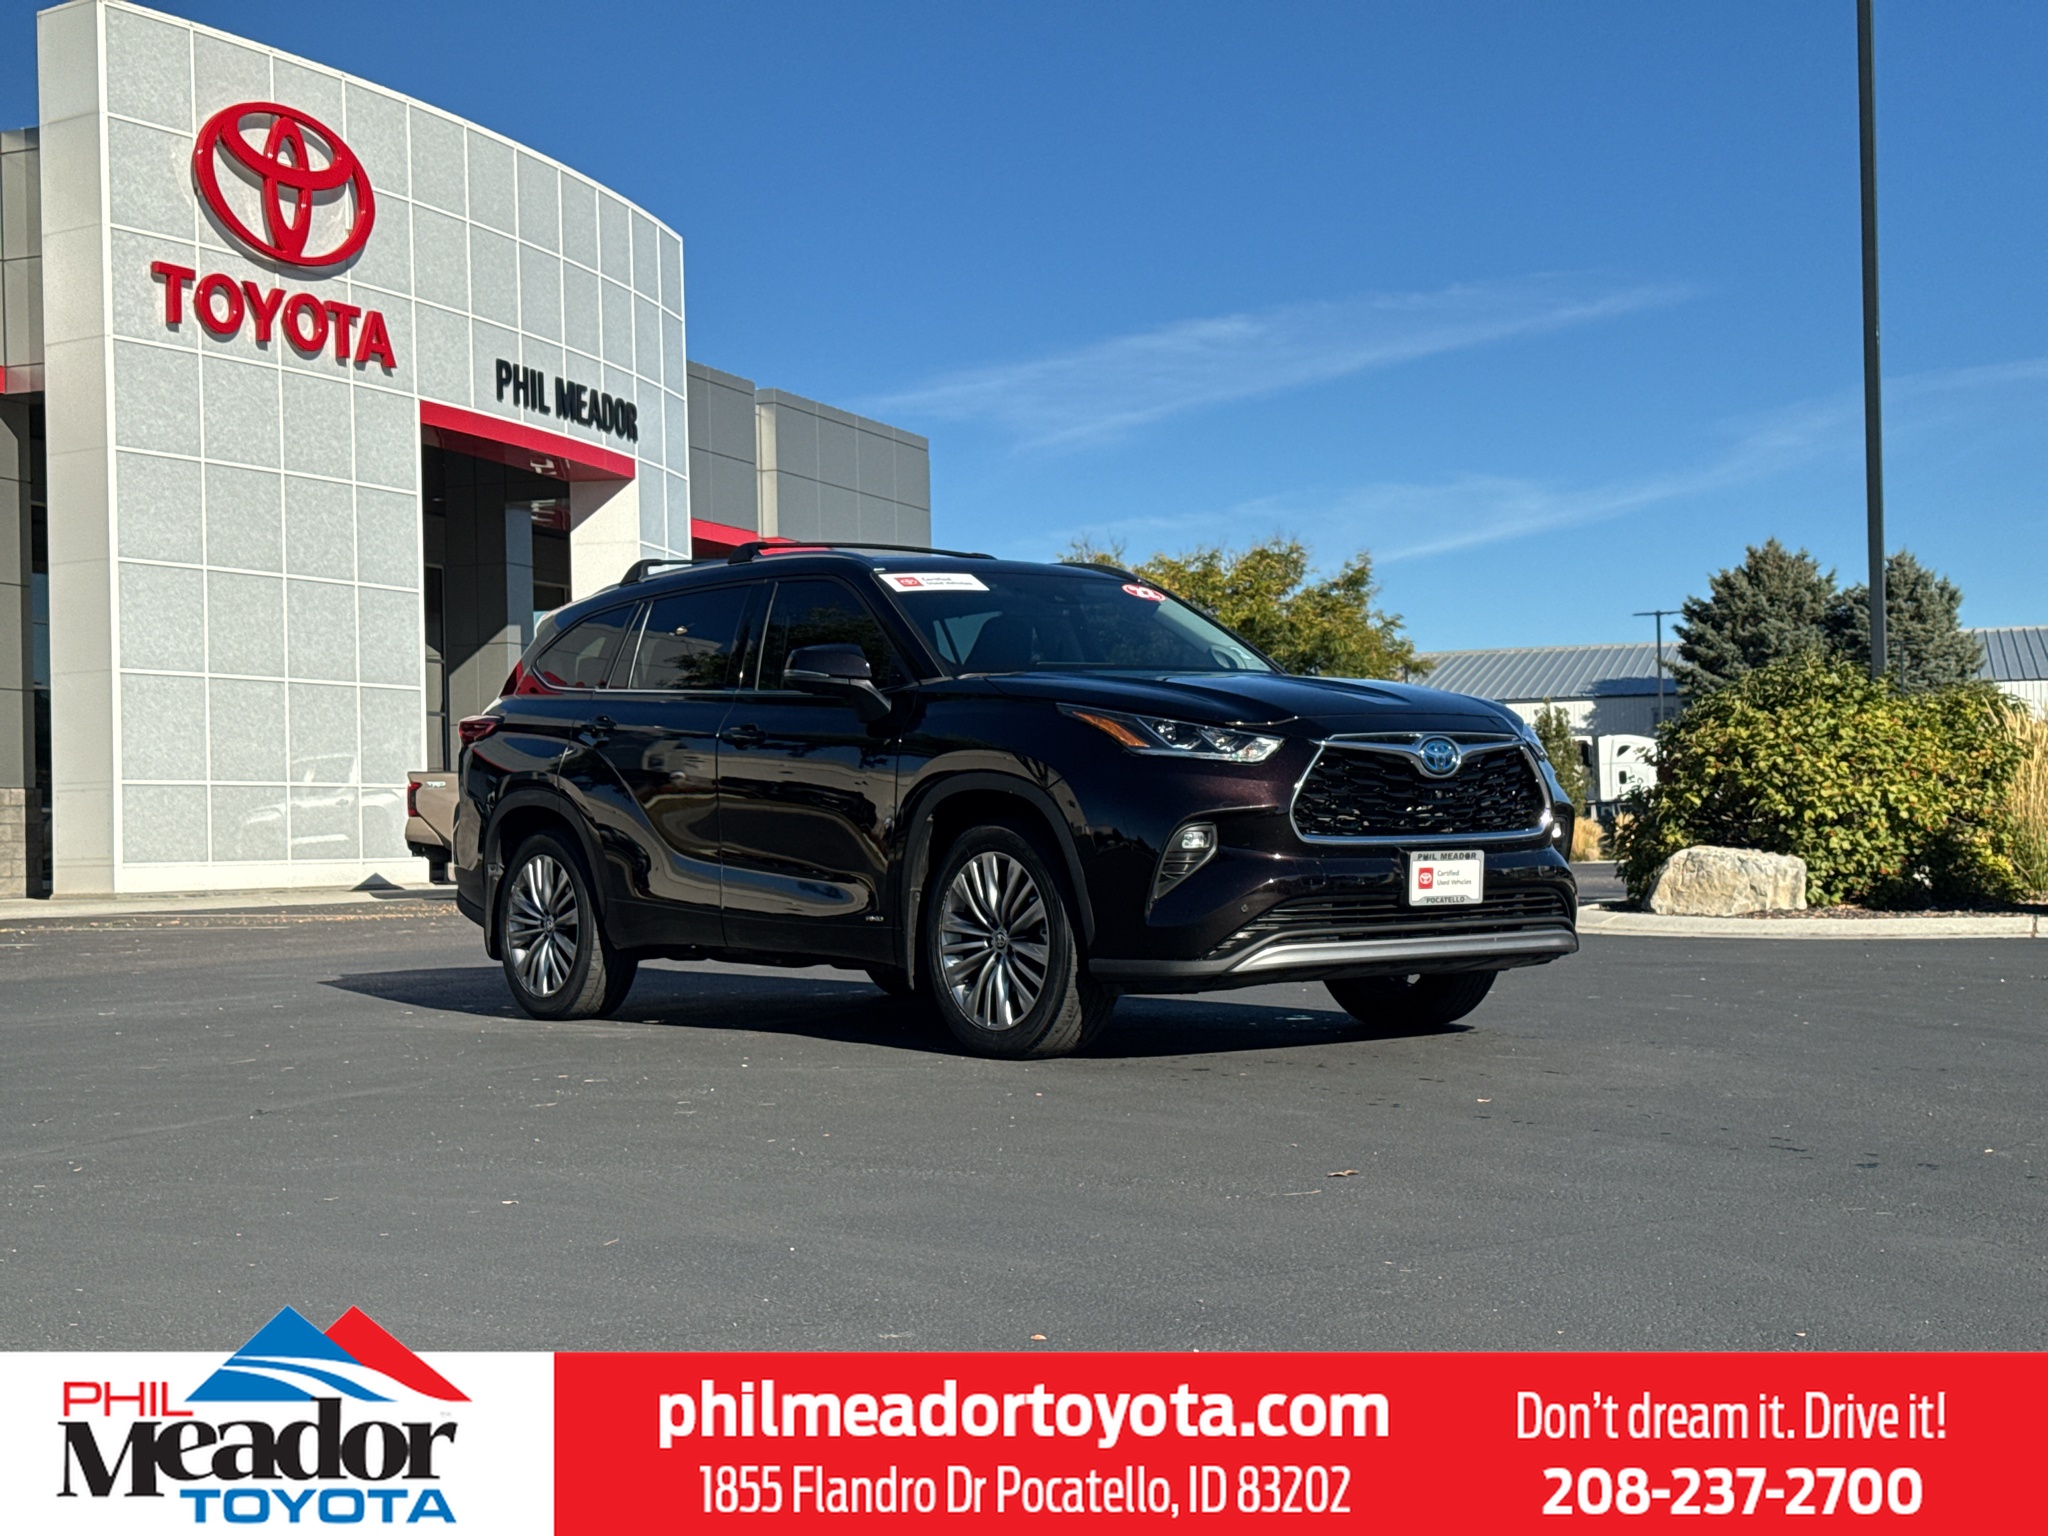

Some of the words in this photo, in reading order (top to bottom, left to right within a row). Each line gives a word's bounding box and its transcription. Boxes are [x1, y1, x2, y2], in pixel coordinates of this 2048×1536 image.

[151, 261, 396, 369] TOYOTA
[495, 358, 551, 415] PHIL
[554, 376, 638, 442] MEADOR
[1440, 852, 1477, 860] MEADOR
[1437, 869, 1460, 877] Certified
[1426, 896, 1465, 904] POCATELLO
